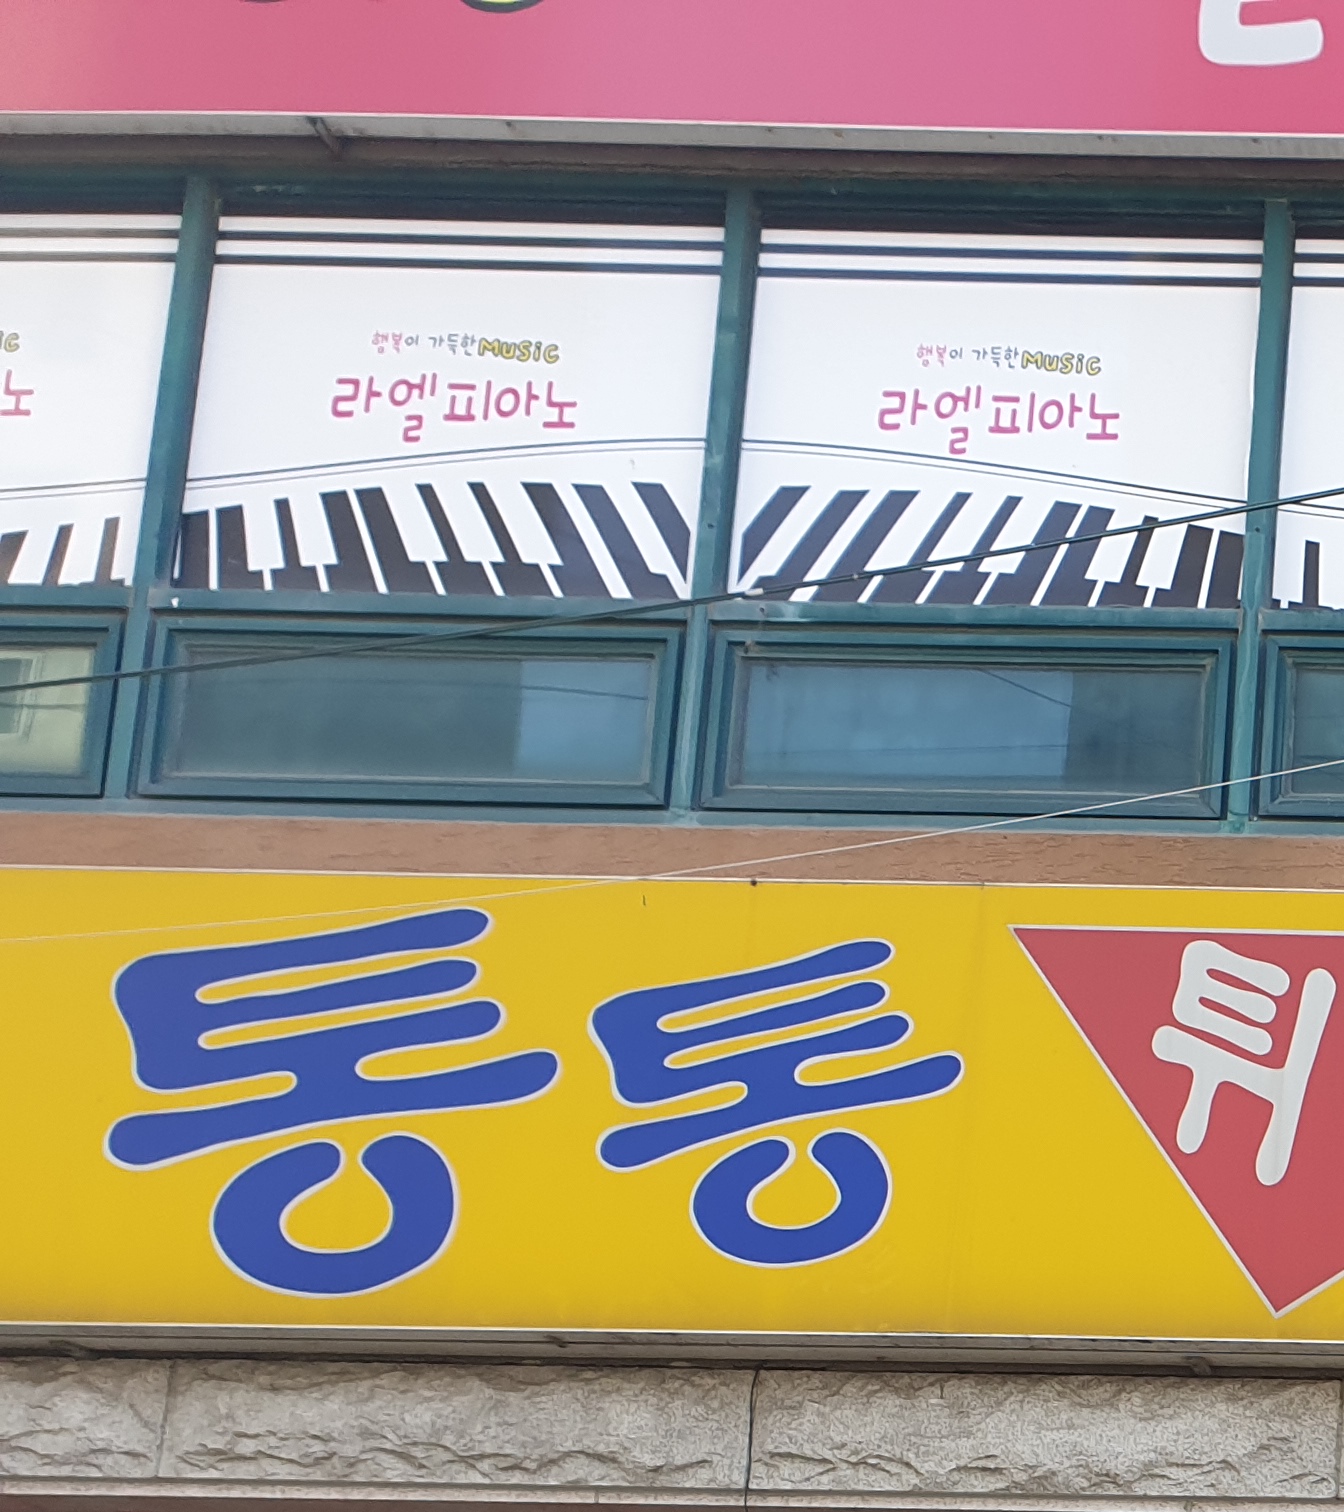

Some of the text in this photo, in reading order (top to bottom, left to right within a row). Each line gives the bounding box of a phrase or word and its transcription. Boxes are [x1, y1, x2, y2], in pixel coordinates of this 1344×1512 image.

[331, 372, 578, 442] 라엘피아노
[878, 384, 1120, 454] 라엘피아노
[103, 907, 964, 1300] 통통
